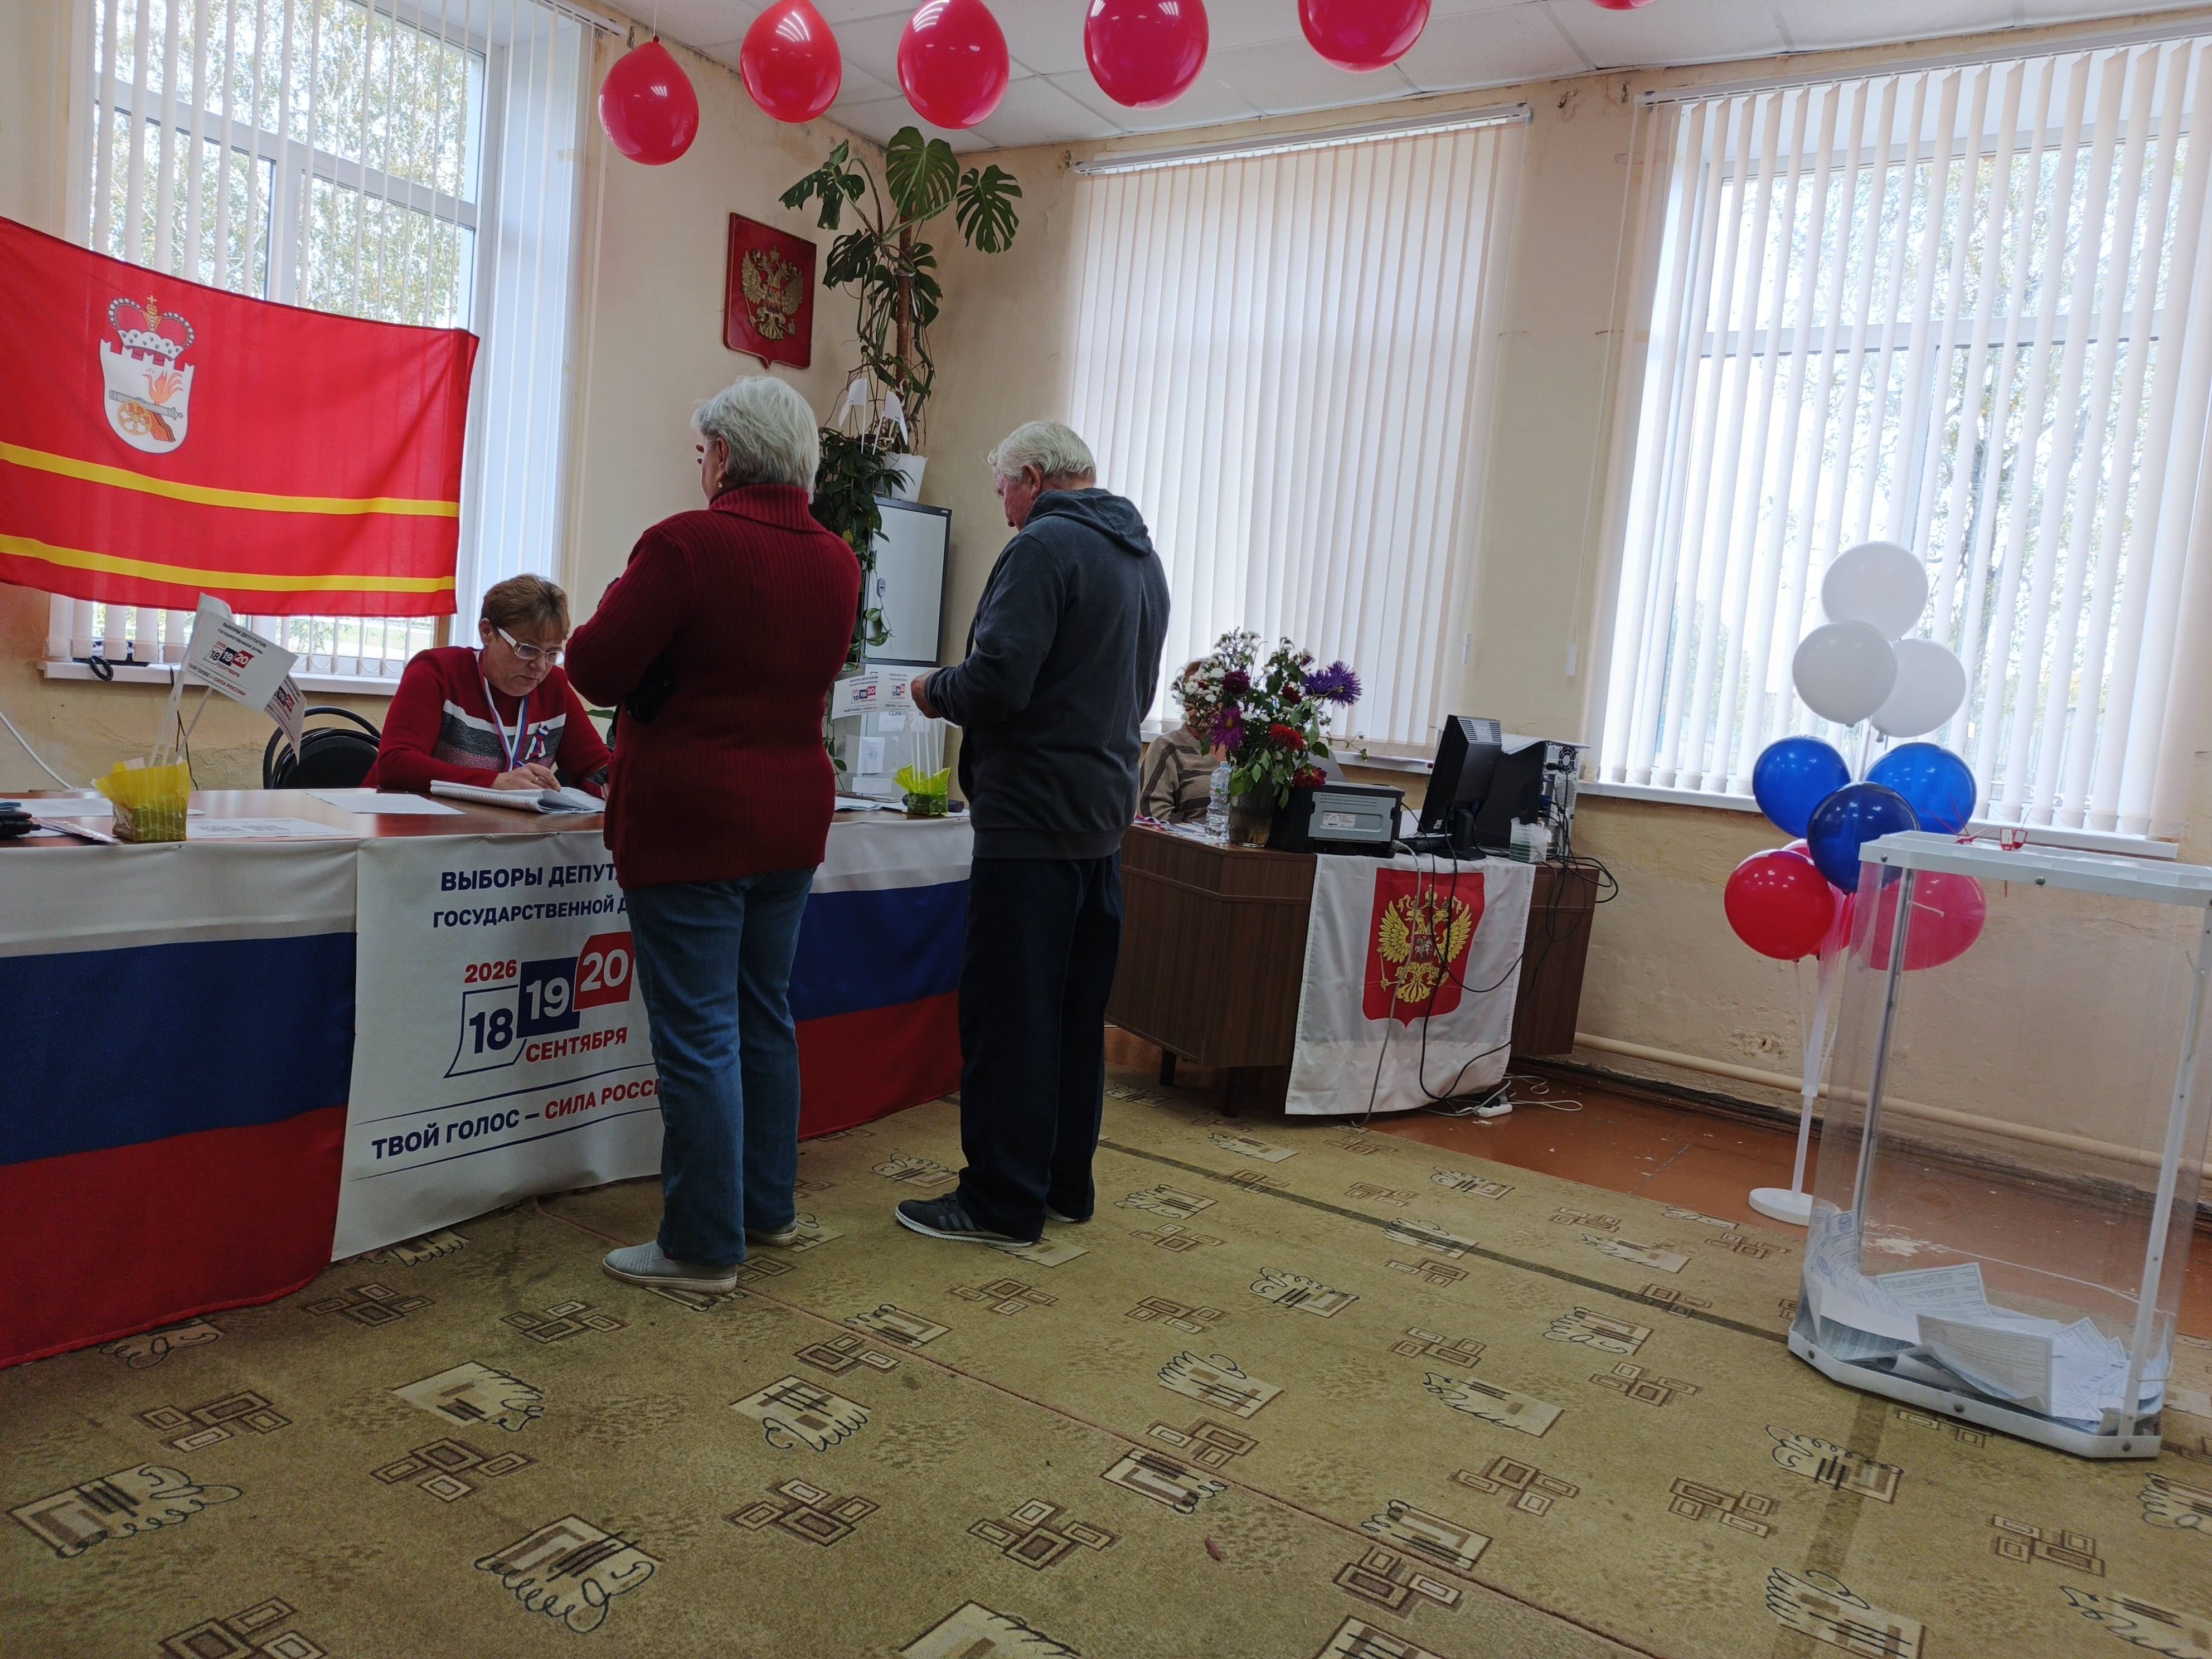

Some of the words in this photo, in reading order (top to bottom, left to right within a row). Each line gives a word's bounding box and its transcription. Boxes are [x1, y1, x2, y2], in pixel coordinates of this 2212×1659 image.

[210, 651, 220, 661] 18
[222, 652, 234, 662] 19
[234, 653, 249, 664] 20
[441, 867, 543, 891] ВЫБОРЫ
[548, 863, 618, 887] ДЕПУТ
[434, 894, 614, 928] ГОСУДАРСТВЕННОЙ
[464, 959, 517, 983] 2026
[469, 1008, 513, 1054] 18
[526, 977, 570, 1021] 19
[580, 949, 629, 991] 20
[525, 1026, 628, 1063] СЕНТЯБРЯ
[372, 1124, 439, 1160] ТВОЙ
[446, 1109, 520, 1143] ГОЛОС
[545, 1091, 596, 1120] СИЛА
